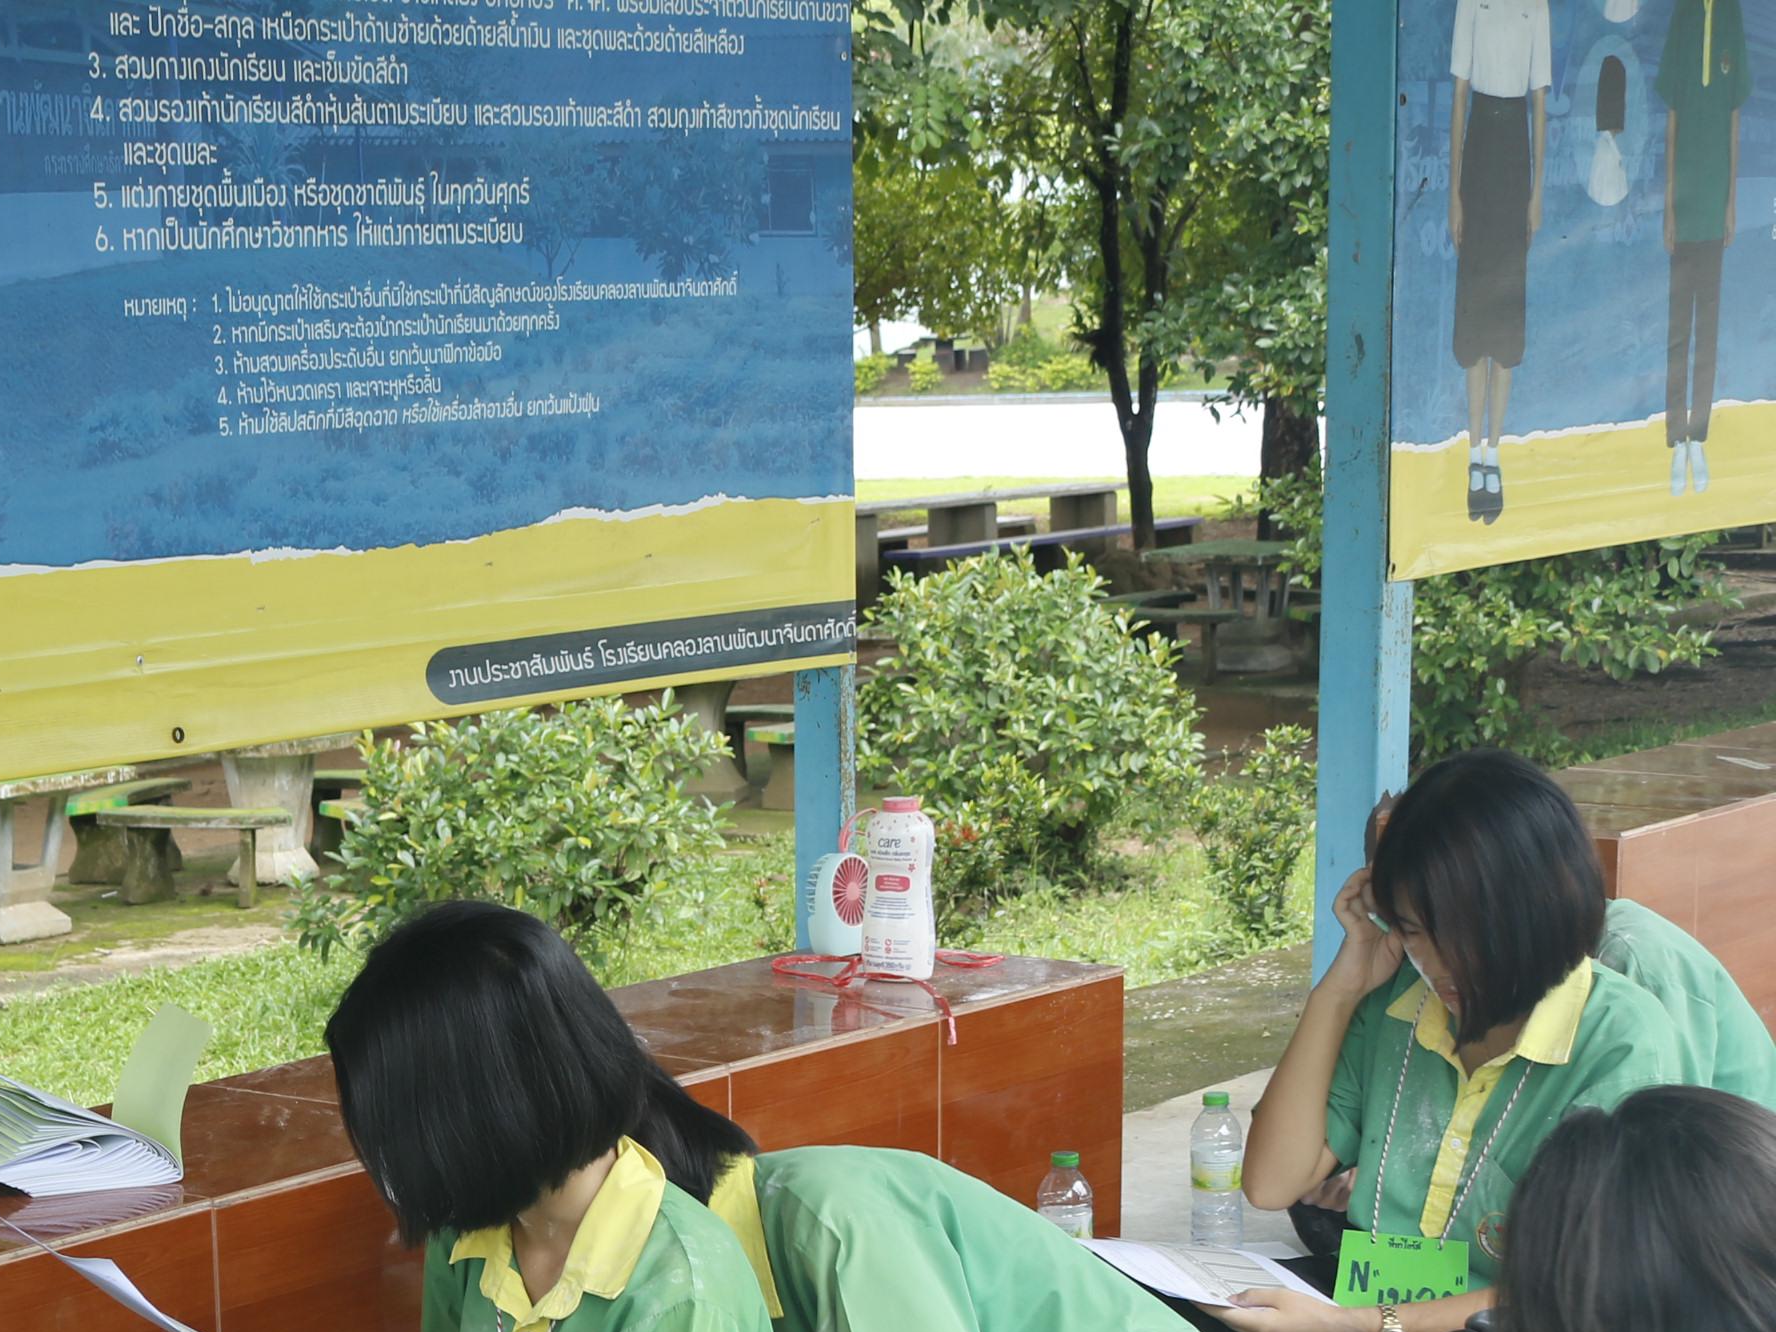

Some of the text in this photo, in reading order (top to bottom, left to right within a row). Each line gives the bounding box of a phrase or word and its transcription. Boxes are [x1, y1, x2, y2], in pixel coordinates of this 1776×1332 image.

[110, 11, 140, 37] และ
[149, 0, 254, 48] ปักชื่อ-สกุล
[557, 24, 745, 58] และชุดพละด้วยด้ายสีเหลือง
[88, 50, 408, 84] 3. สวมกางเกงนักเรียน และเข็มขัดสีดำ
[90, 95, 110, 123] 4.
[474, 98, 641, 129] และสวมรองเท้าพละสีดำ
[124, 141, 217, 174] และชุดพละ
[94, 169, 530, 216] 5. แต่งกายชุดพื้นเมือง หรือชุดชาติพันธุ์ ในทุกวันศุกร์
[95, 211, 523, 251] 6. หากเป็นนักศึกษาวิชาทหาร ให้แต่งกายตามระเบียบ
[124, 299, 188, 321] หมายเหตุ
[212, 294, 222, 313] 1.
[213, 326, 226, 345] 2.
[215, 356, 228, 375] 3.
[233, 341, 385, 375] ห้ามสวมเครื่องประดับอื่น
[217, 387, 232, 406] 4.
[237, 378, 340, 405] ห้ามไว้หนวดเครา
[219, 418, 233, 437] 5.
[448, 646, 594, 689] งานประชาสัมพันธ์
[877, 837, 902, 849] care
